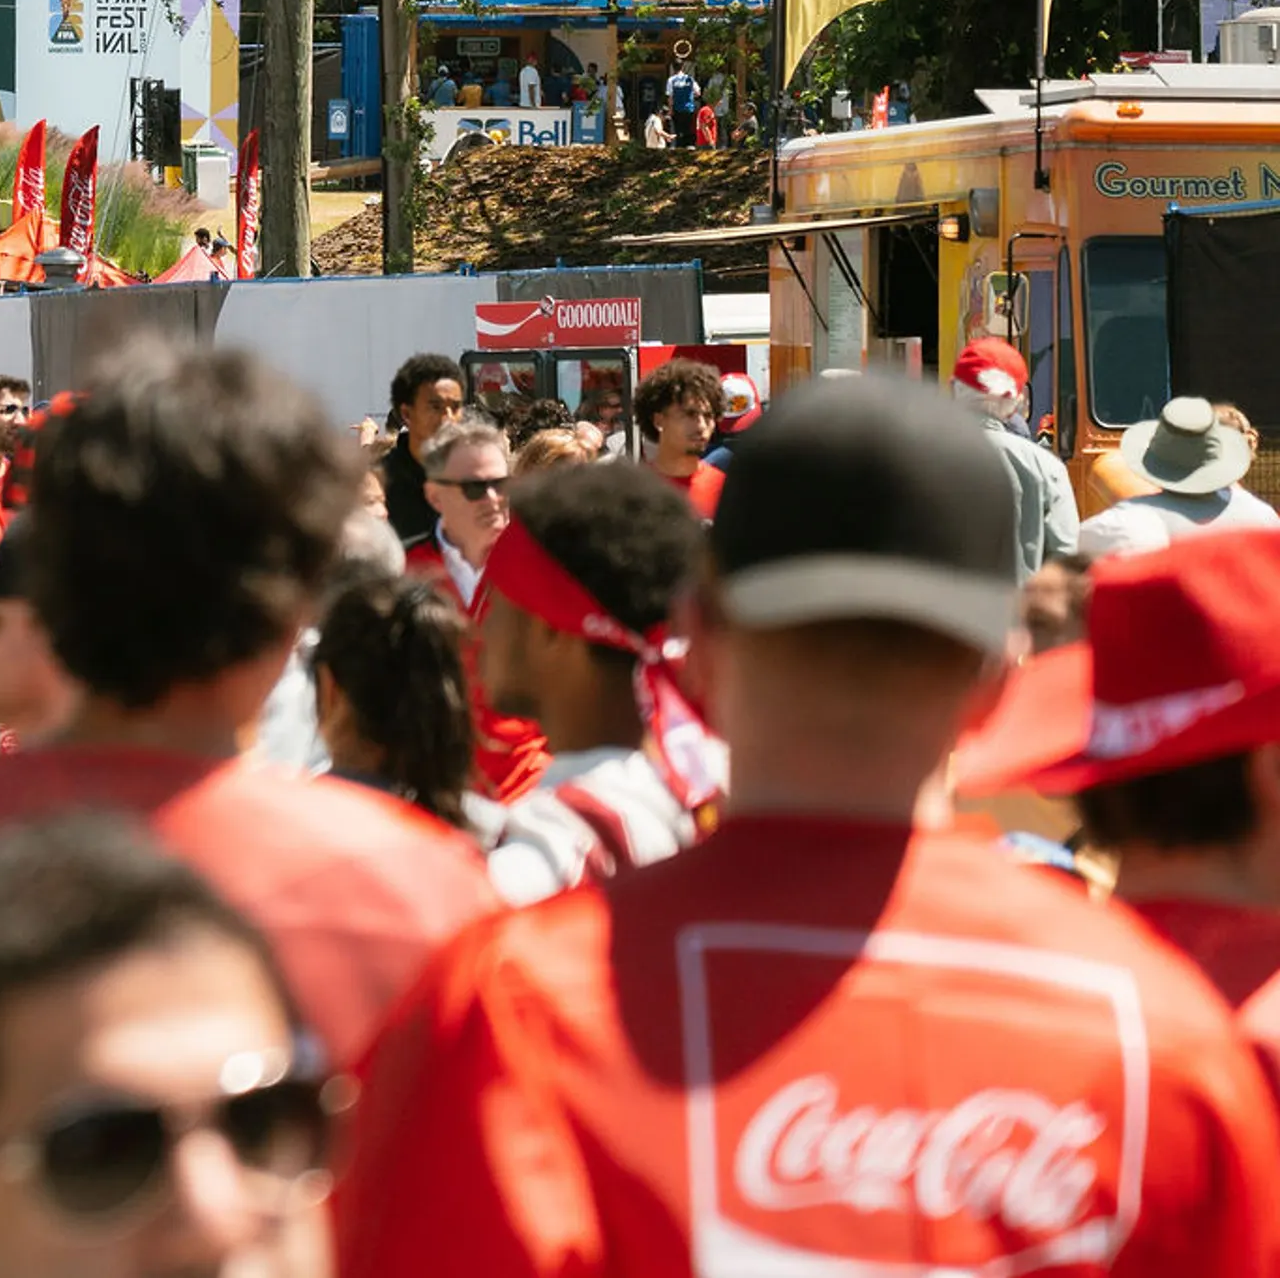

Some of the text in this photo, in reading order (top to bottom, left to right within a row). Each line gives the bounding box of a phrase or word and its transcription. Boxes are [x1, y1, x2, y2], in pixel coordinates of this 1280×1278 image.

[96, 7, 147, 28] FEST
[518, 119, 567, 146] Bell
[1096, 162, 1246, 198] Gourmet
[557, 301, 638, 329] GOOOOOOAL!
[734, 1072, 1106, 1235] Coca-Cola
